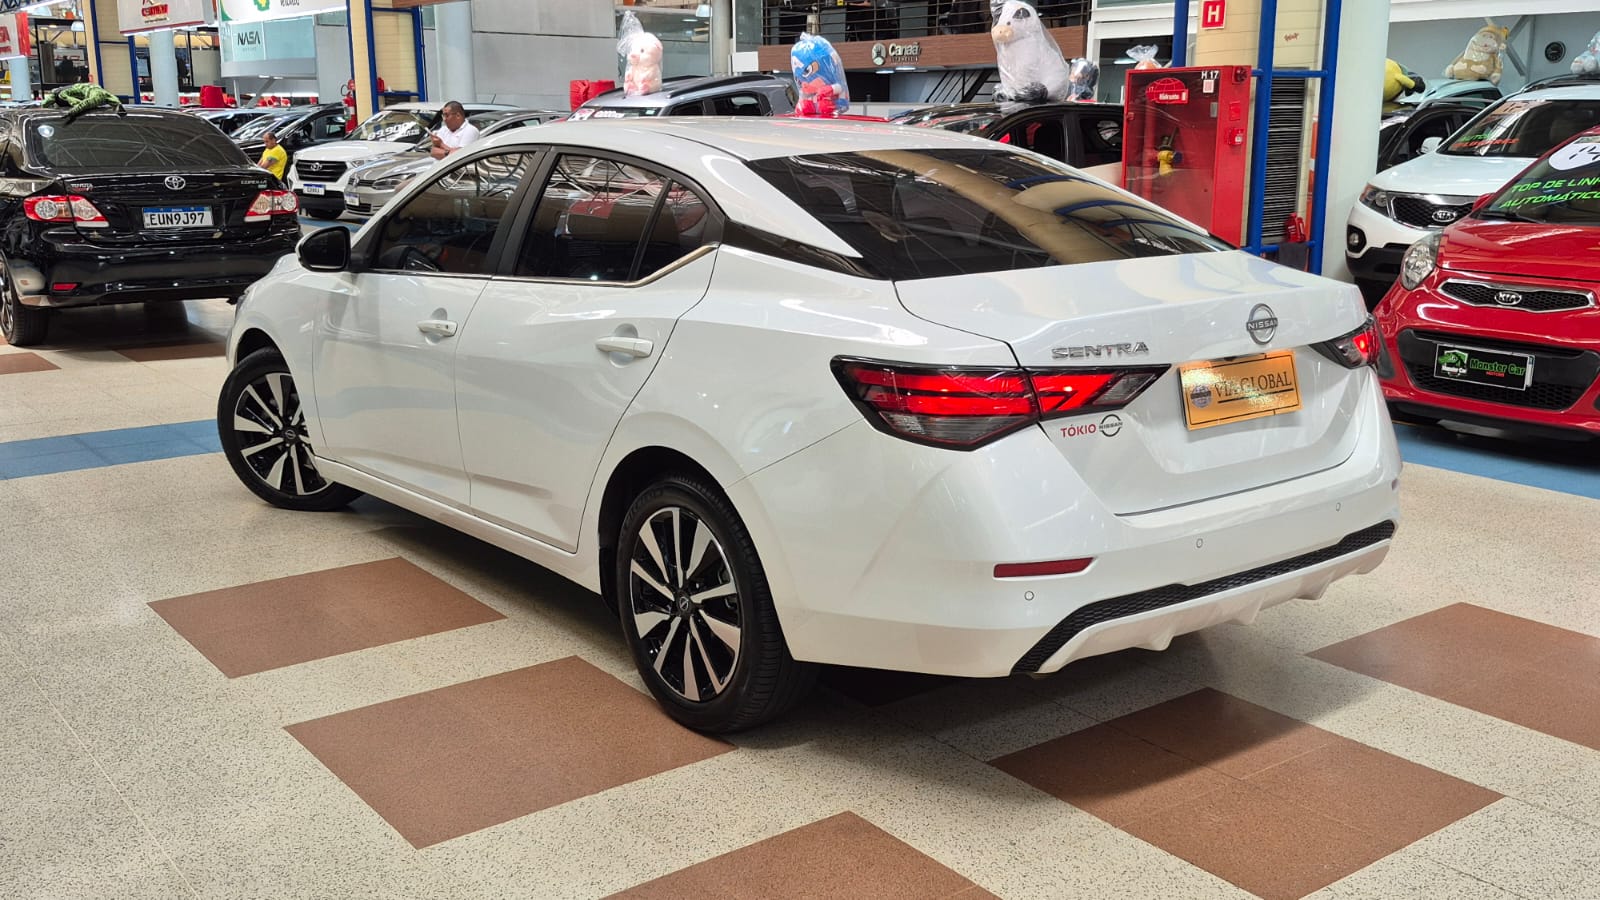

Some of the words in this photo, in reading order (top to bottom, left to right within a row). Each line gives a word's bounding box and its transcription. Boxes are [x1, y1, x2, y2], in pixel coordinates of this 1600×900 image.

[1207, 5, 1220, 23] H
[237, 31, 261, 46] NASA
[1201, 71, 1208, 80] H
[1210, 70, 1219, 80] 17
[1510, 181, 1541, 193] TOP
[1542, 179, 1566, 189] DE
[149, 212, 205, 226] EUN9J97
[1247, 317, 1278, 330] NISSAN
[1051, 341, 1150, 360] SENTRA
[1470, 358, 1507, 373] Monster
[1508, 364, 1526, 377] Car
[1240, 371, 1292, 393] GLOBAL
[1060, 424, 1097, 438] TÓKIO
[1099, 421, 1124, 430] NISSAN
